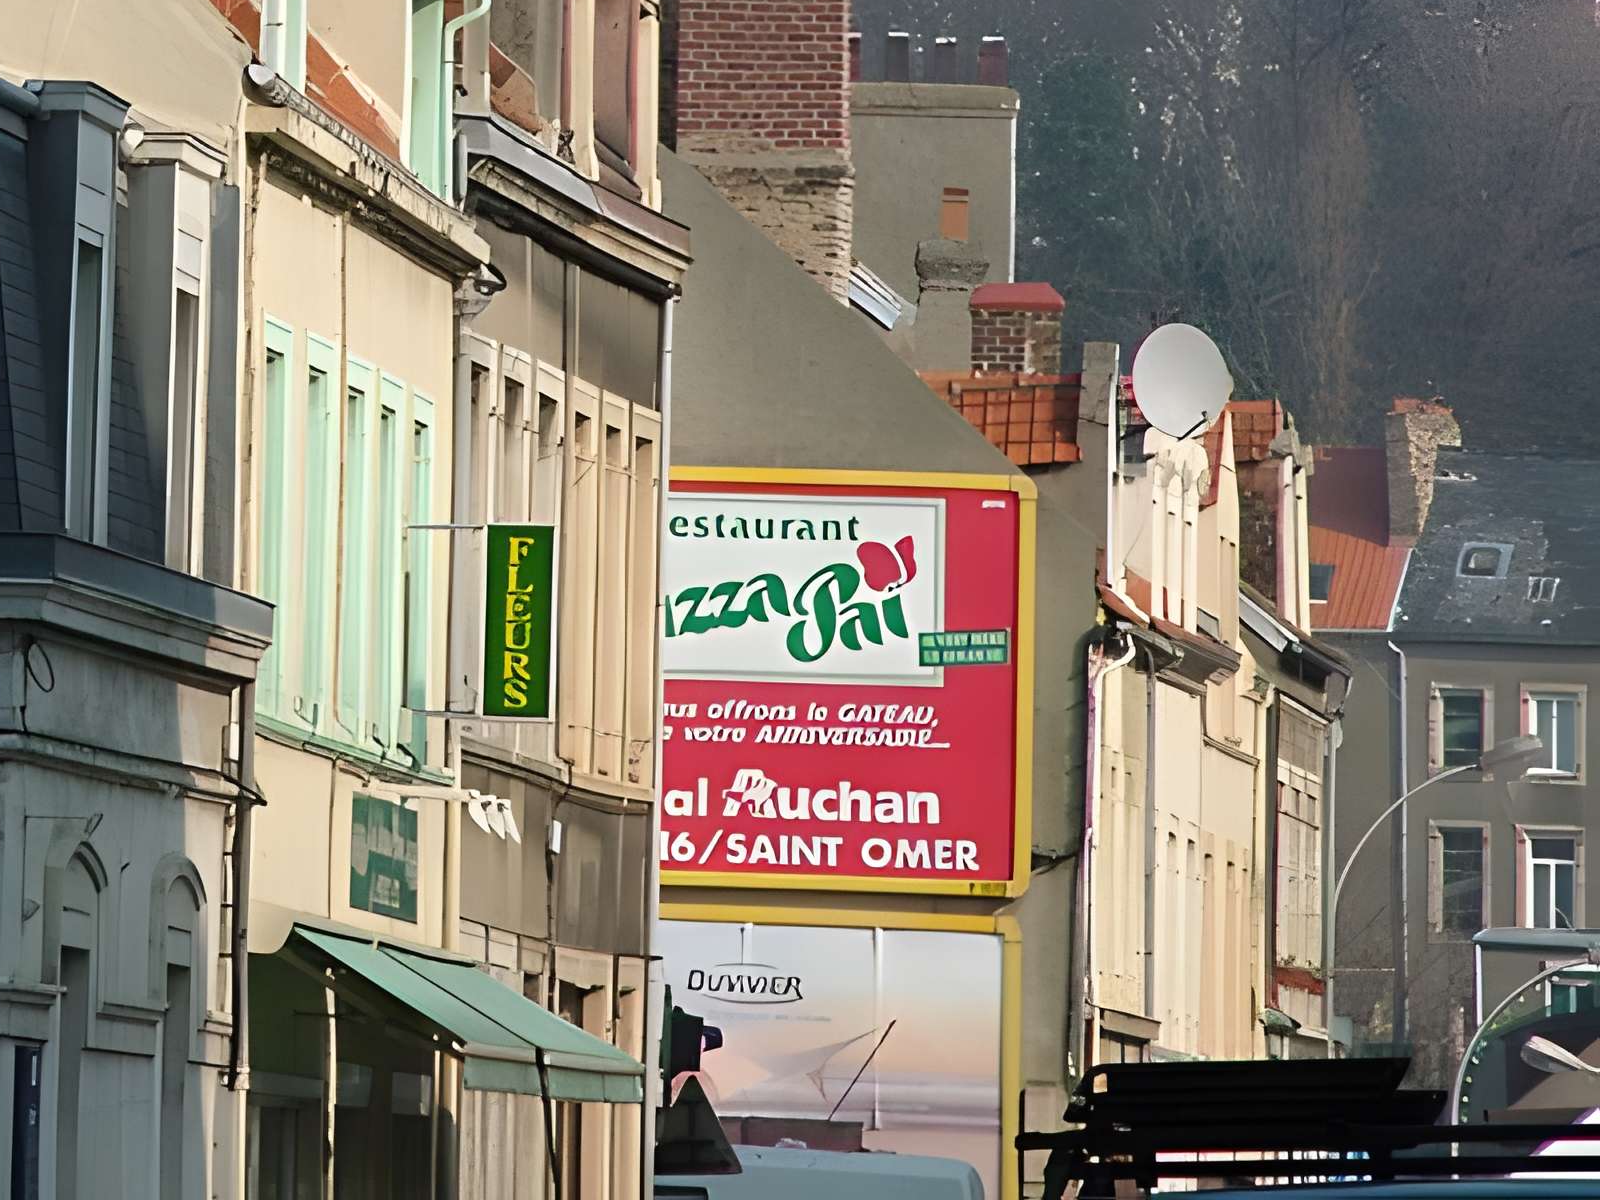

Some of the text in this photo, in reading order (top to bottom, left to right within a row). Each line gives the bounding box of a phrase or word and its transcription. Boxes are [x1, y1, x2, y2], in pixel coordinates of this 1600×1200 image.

[669, 513, 859, 541] estaurant
[503, 536, 535, 708] FLEURS
[663, 768, 941, 825] al Auchan
[661, 829, 980, 872] 16/SAINT OMER
